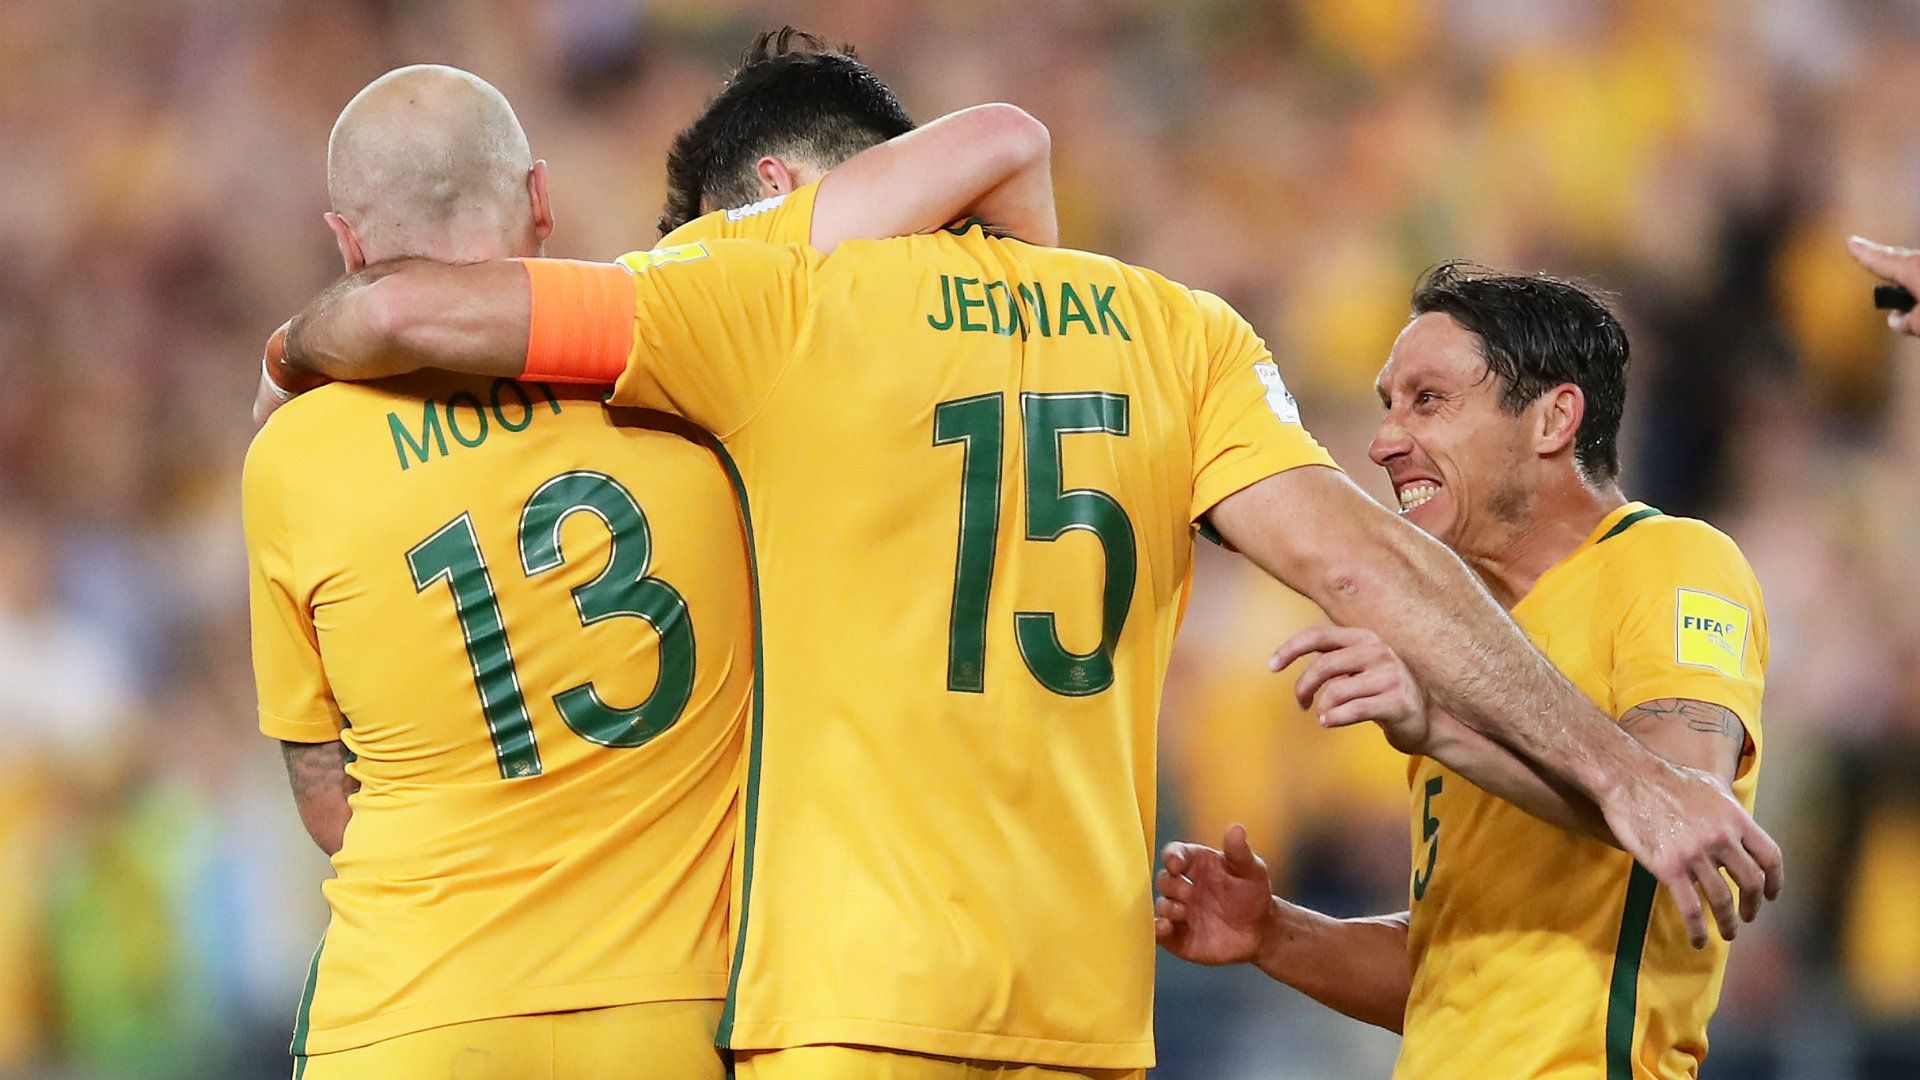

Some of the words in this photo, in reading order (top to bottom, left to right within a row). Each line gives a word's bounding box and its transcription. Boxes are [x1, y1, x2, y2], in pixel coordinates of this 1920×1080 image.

[405, 470, 696, 780] 13
[932, 391, 1137, 696] 15
[1683, 615, 1723, 637] FIFA
[1414, 776, 1443, 901] 5
